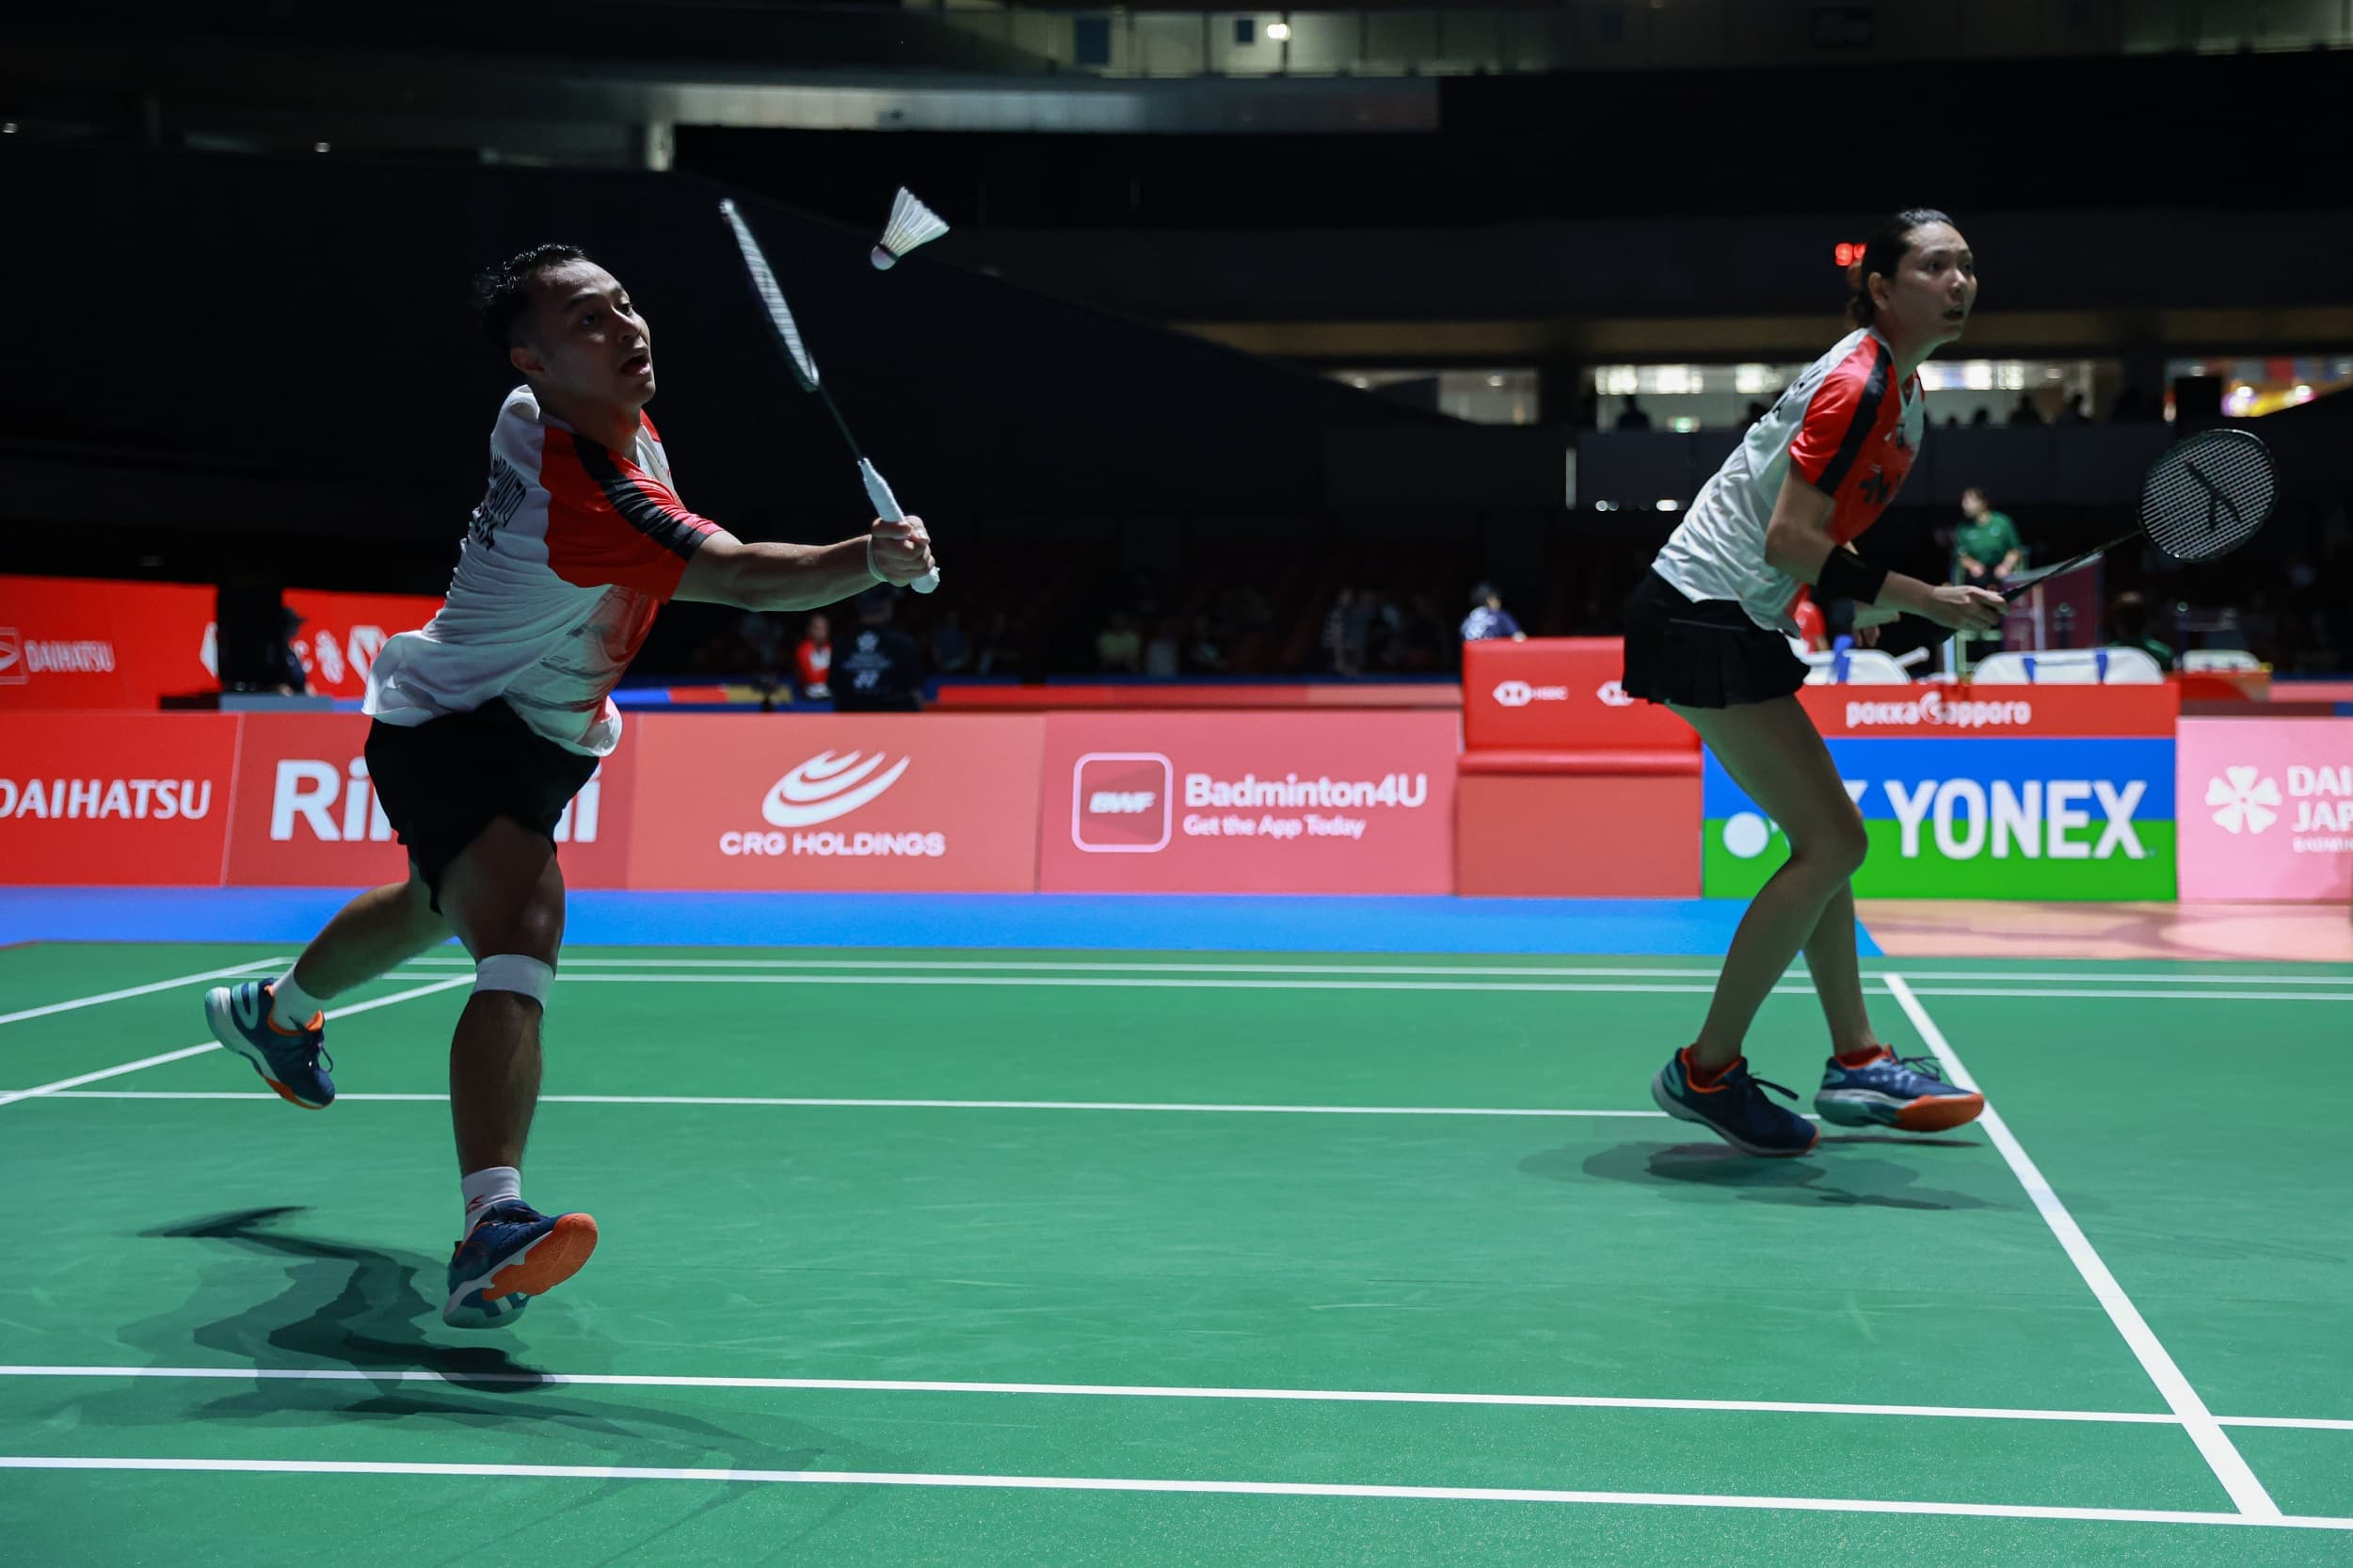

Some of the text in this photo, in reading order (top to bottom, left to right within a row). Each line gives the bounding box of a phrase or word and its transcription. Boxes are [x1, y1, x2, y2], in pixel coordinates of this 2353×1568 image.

[24, 640, 115, 672] DAIHATSU
[270, 756, 601, 842] Rii
[1185, 774, 1427, 808] Badminton4U
[1183, 814, 1367, 840] Get the App Today
[1882, 778, 2149, 860] YONEX
[719, 831, 947, 857] CRG HOLDINGS
